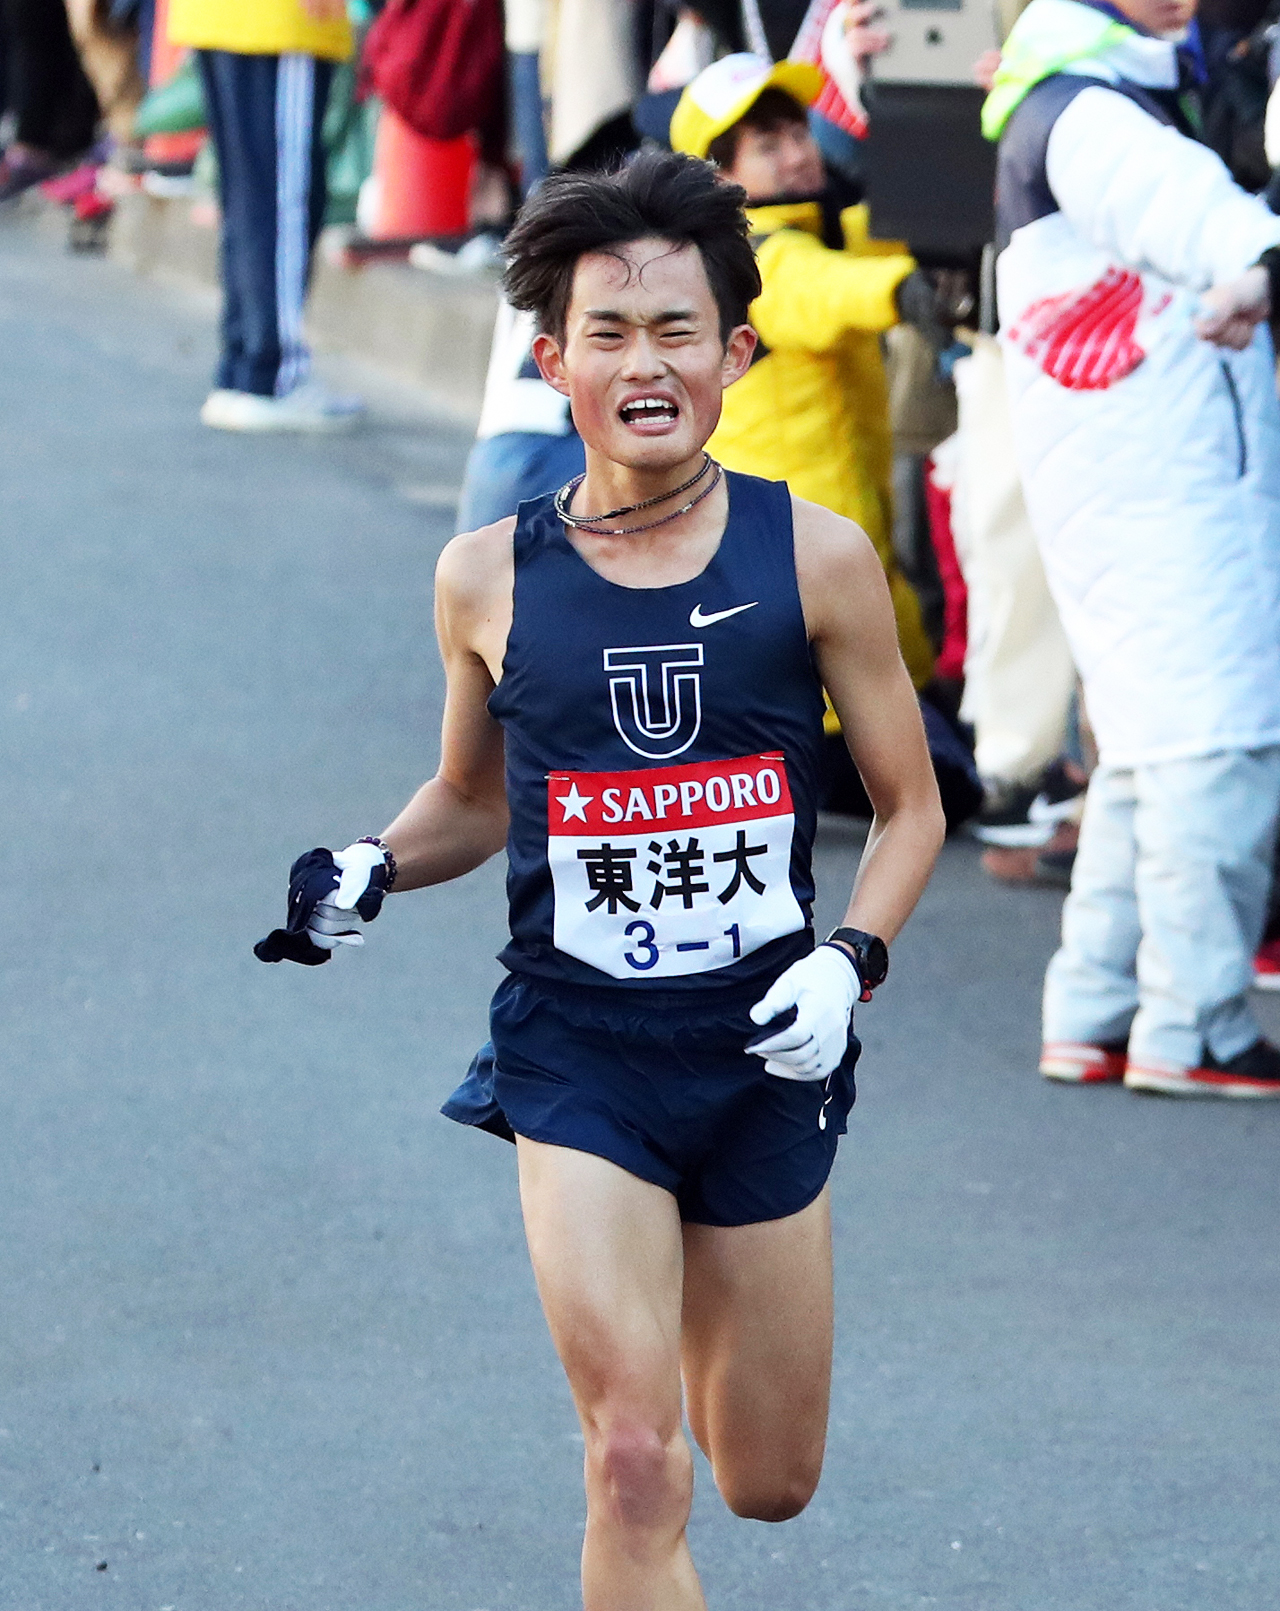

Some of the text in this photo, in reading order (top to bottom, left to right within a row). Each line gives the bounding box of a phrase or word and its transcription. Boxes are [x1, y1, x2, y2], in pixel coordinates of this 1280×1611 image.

[602, 768, 781, 824] SAPPORO
[577, 830, 769, 914] 東洋大
